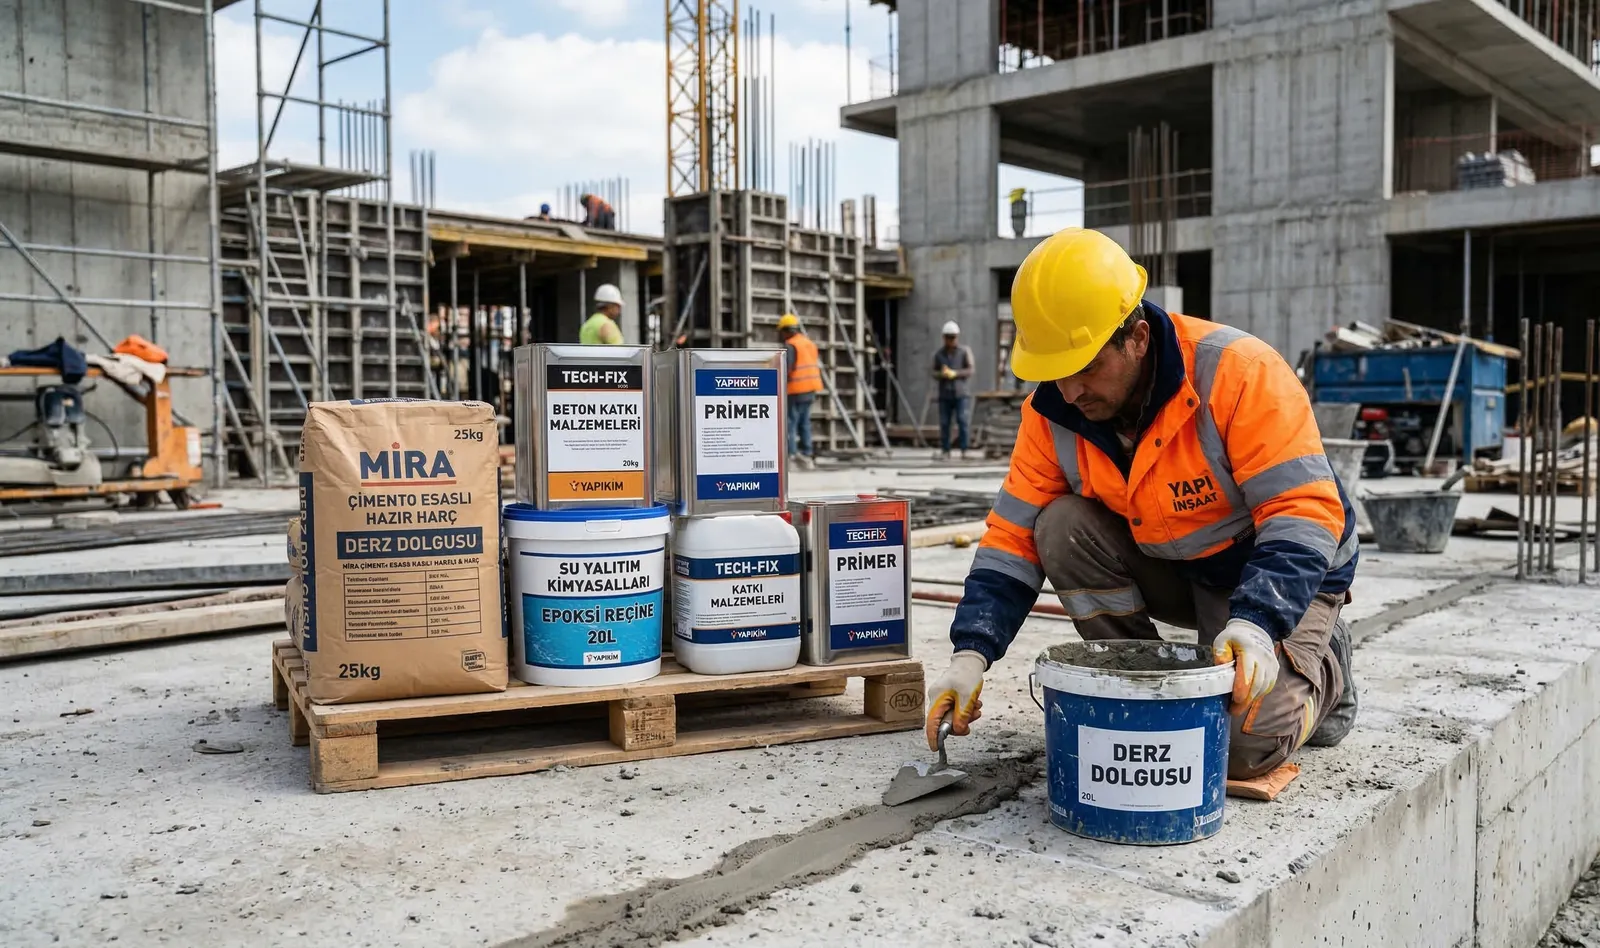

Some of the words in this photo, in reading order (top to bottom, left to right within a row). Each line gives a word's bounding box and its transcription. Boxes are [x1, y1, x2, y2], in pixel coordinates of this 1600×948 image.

[562, 371, 627, 383] TECH-FIX
[553, 404, 595, 415] BETON
[600, 404, 637, 415] KATKI
[705, 400, 769, 419] PRİMER
[550, 416, 640, 431] MALZEMELERİ
[454, 429, 483, 441] 25kg
[622, 460, 639, 468] 20kg
[581, 480, 623, 491] YAPIKİM
[725, 480, 760, 491] YAPIKİM
[1168, 476, 1213, 498] YAPI
[348, 492, 416, 511] ÇİMENTO
[422, 492, 471, 506] ESASLI
[1172, 492, 1218, 512] İNŞAAT
[366, 511, 412, 525] HAZIR
[417, 510, 457, 525] HARÇ
[345, 537, 392, 554] DERZ
[397, 534, 477, 552] DOLGUSU
[559, 562, 579, 575] SU
[584, 560, 641, 575] YALITIM
[715, 560, 779, 575] TECH-FIX
[837, 552, 897, 572] PRİMER
[547, 575, 650, 592] KİMYASALLARI
[732, 584, 763, 595] KATKI
[711, 592, 784, 608] MALZEMELERİ
[542, 605, 600, 623] EPOKSİ
[605, 602, 654, 624] REÇİNE
[588, 630, 616, 645] 20L
[855, 627, 888, 640] YAPIKİM
[339, 663, 381, 681] 25kg
[1113, 743, 1171, 763] DERZ
[1091, 764, 1192, 787] DOLGUSU
[1081, 792, 1096, 802] 20L
